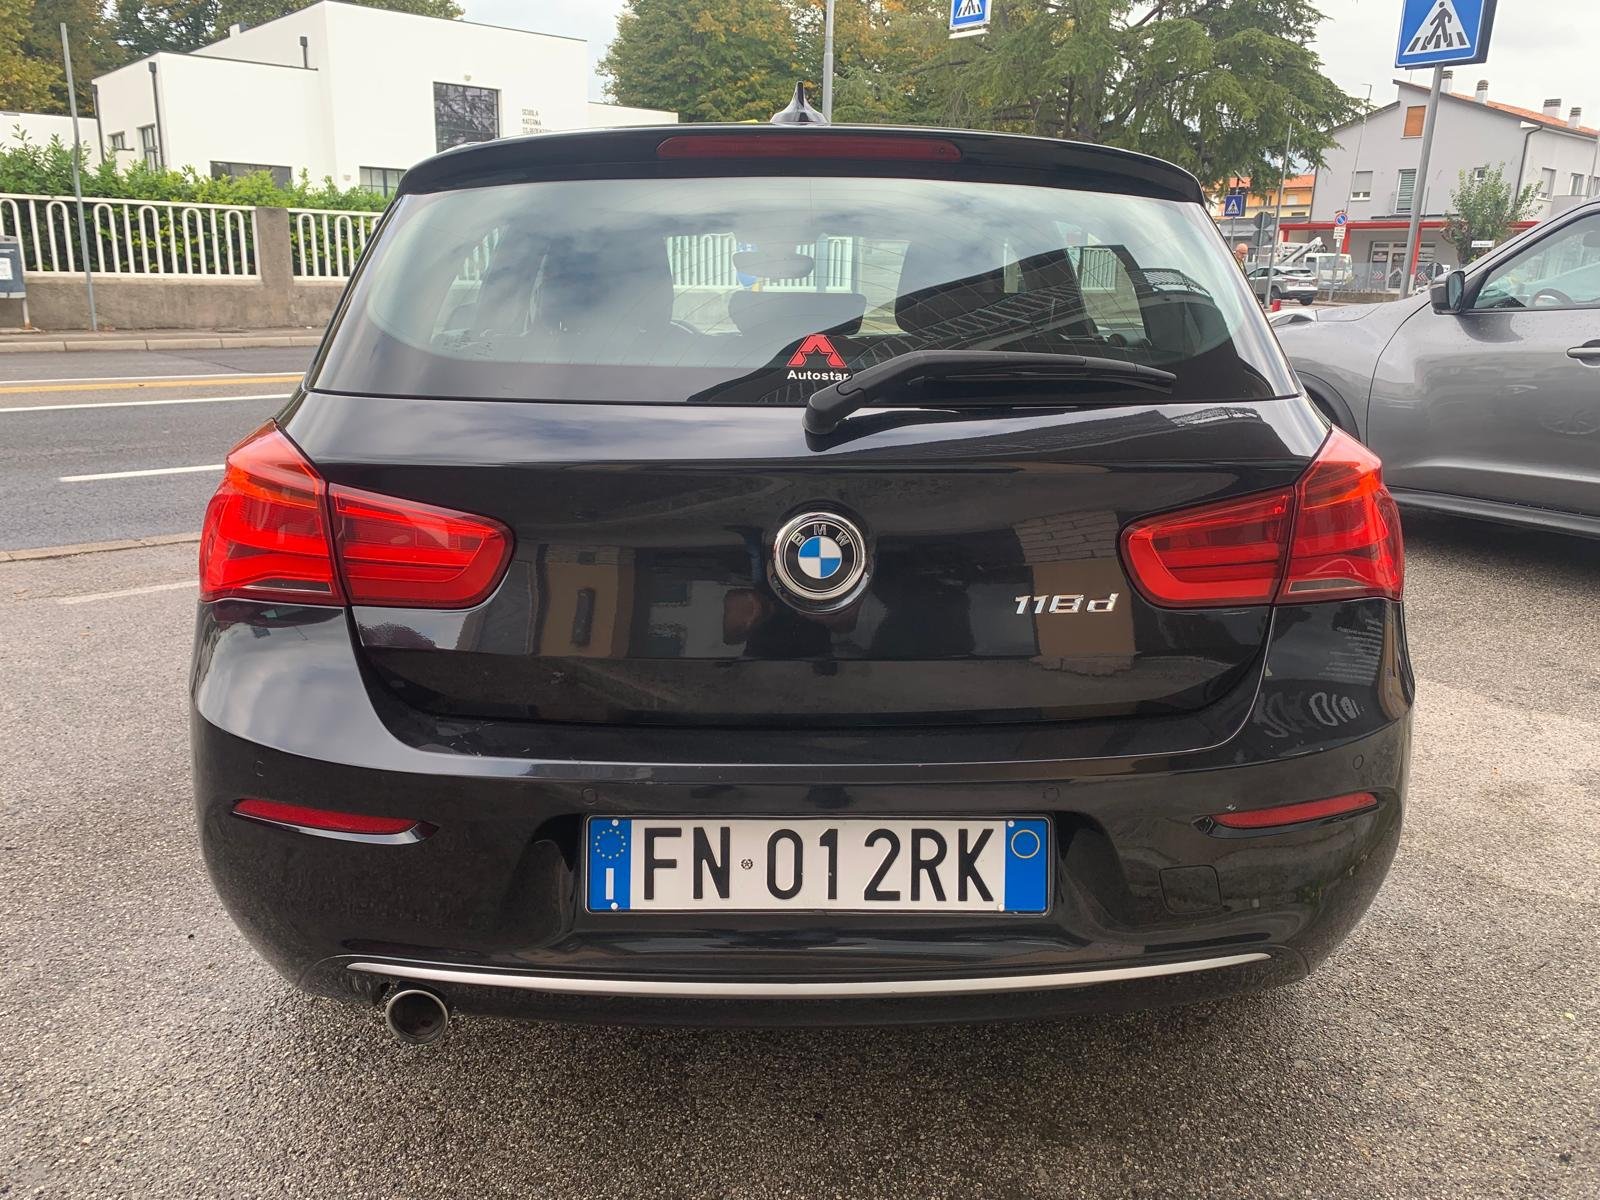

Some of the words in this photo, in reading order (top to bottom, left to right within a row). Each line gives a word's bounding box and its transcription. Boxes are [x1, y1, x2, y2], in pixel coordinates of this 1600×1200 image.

[786, 369, 850, 381] Autostar
[791, 524, 849, 547] BMW
[1015, 592, 1119, 614] 118d
